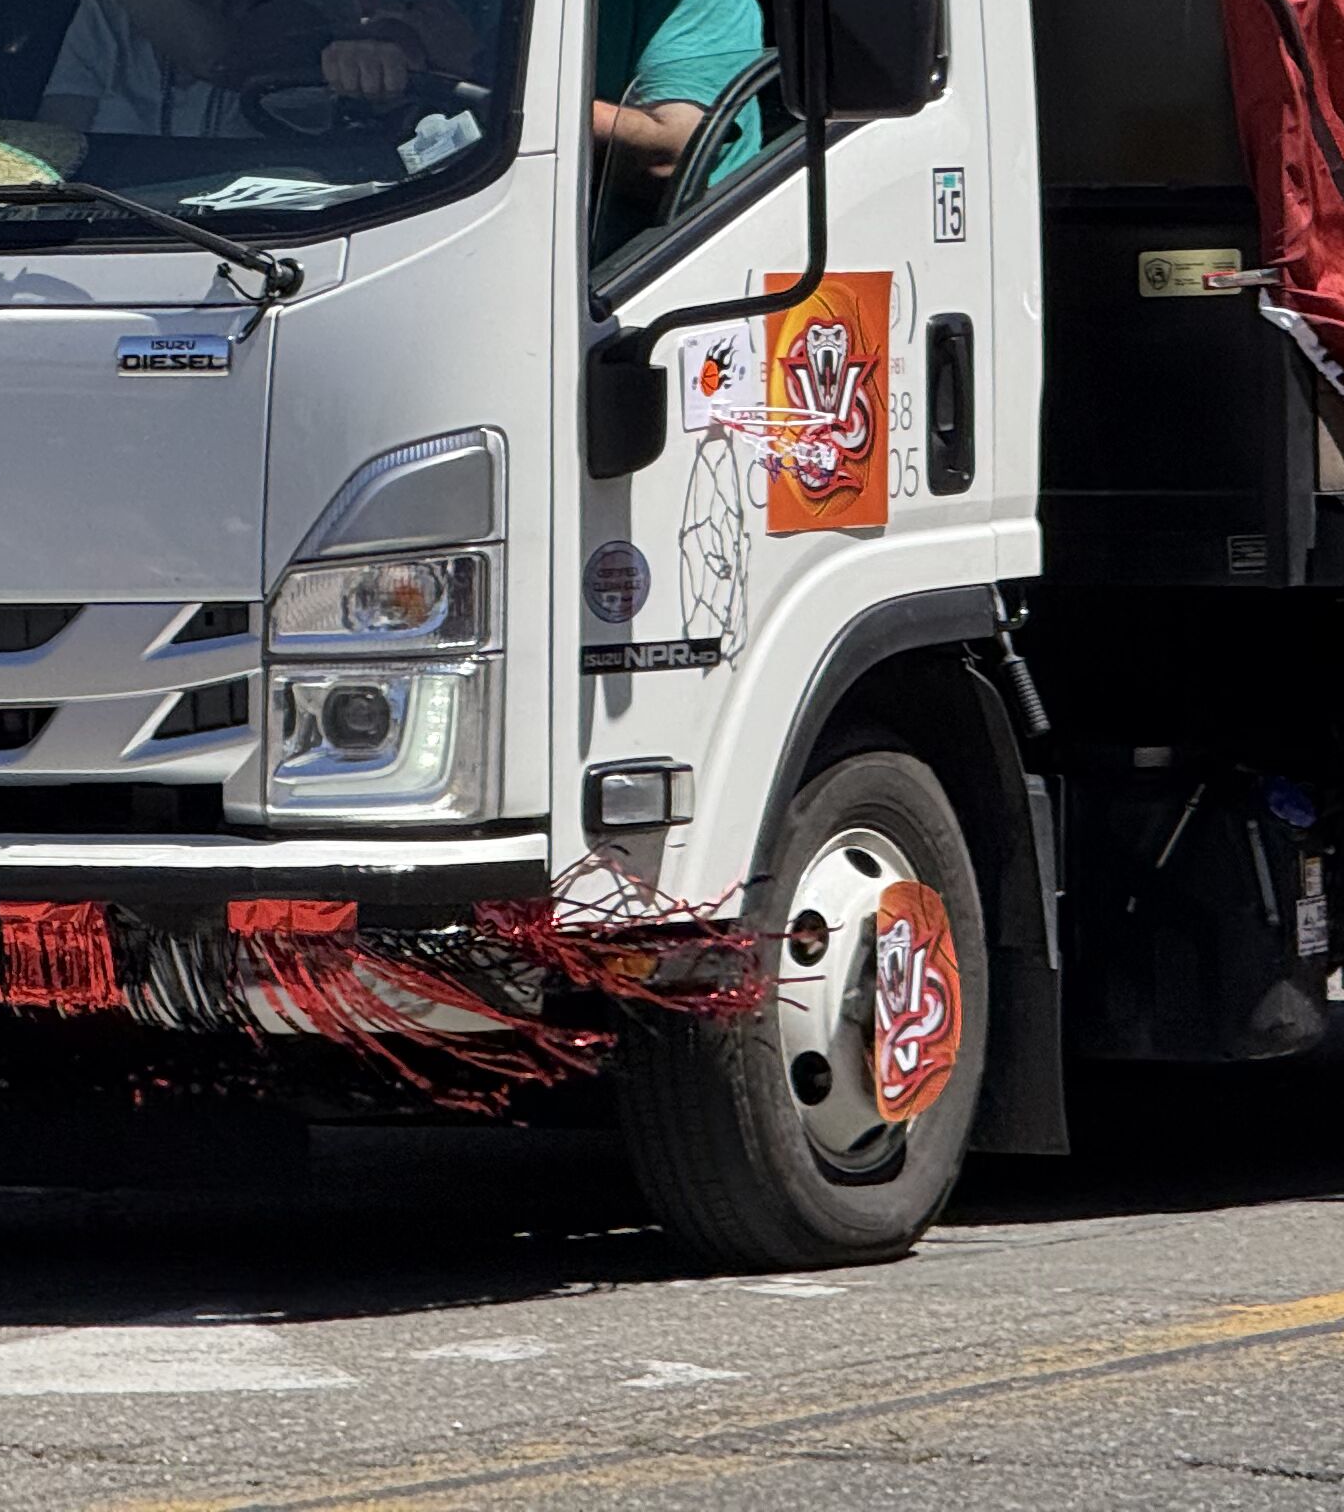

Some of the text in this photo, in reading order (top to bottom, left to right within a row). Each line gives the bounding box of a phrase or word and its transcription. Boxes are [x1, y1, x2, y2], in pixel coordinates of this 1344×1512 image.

[937, 189, 962, 236] 15
[150, 339, 196, 350] ISUZU
[121, 354, 228, 370] DIESEL
[583, 642, 719, 669] ISUZU NPR HD
